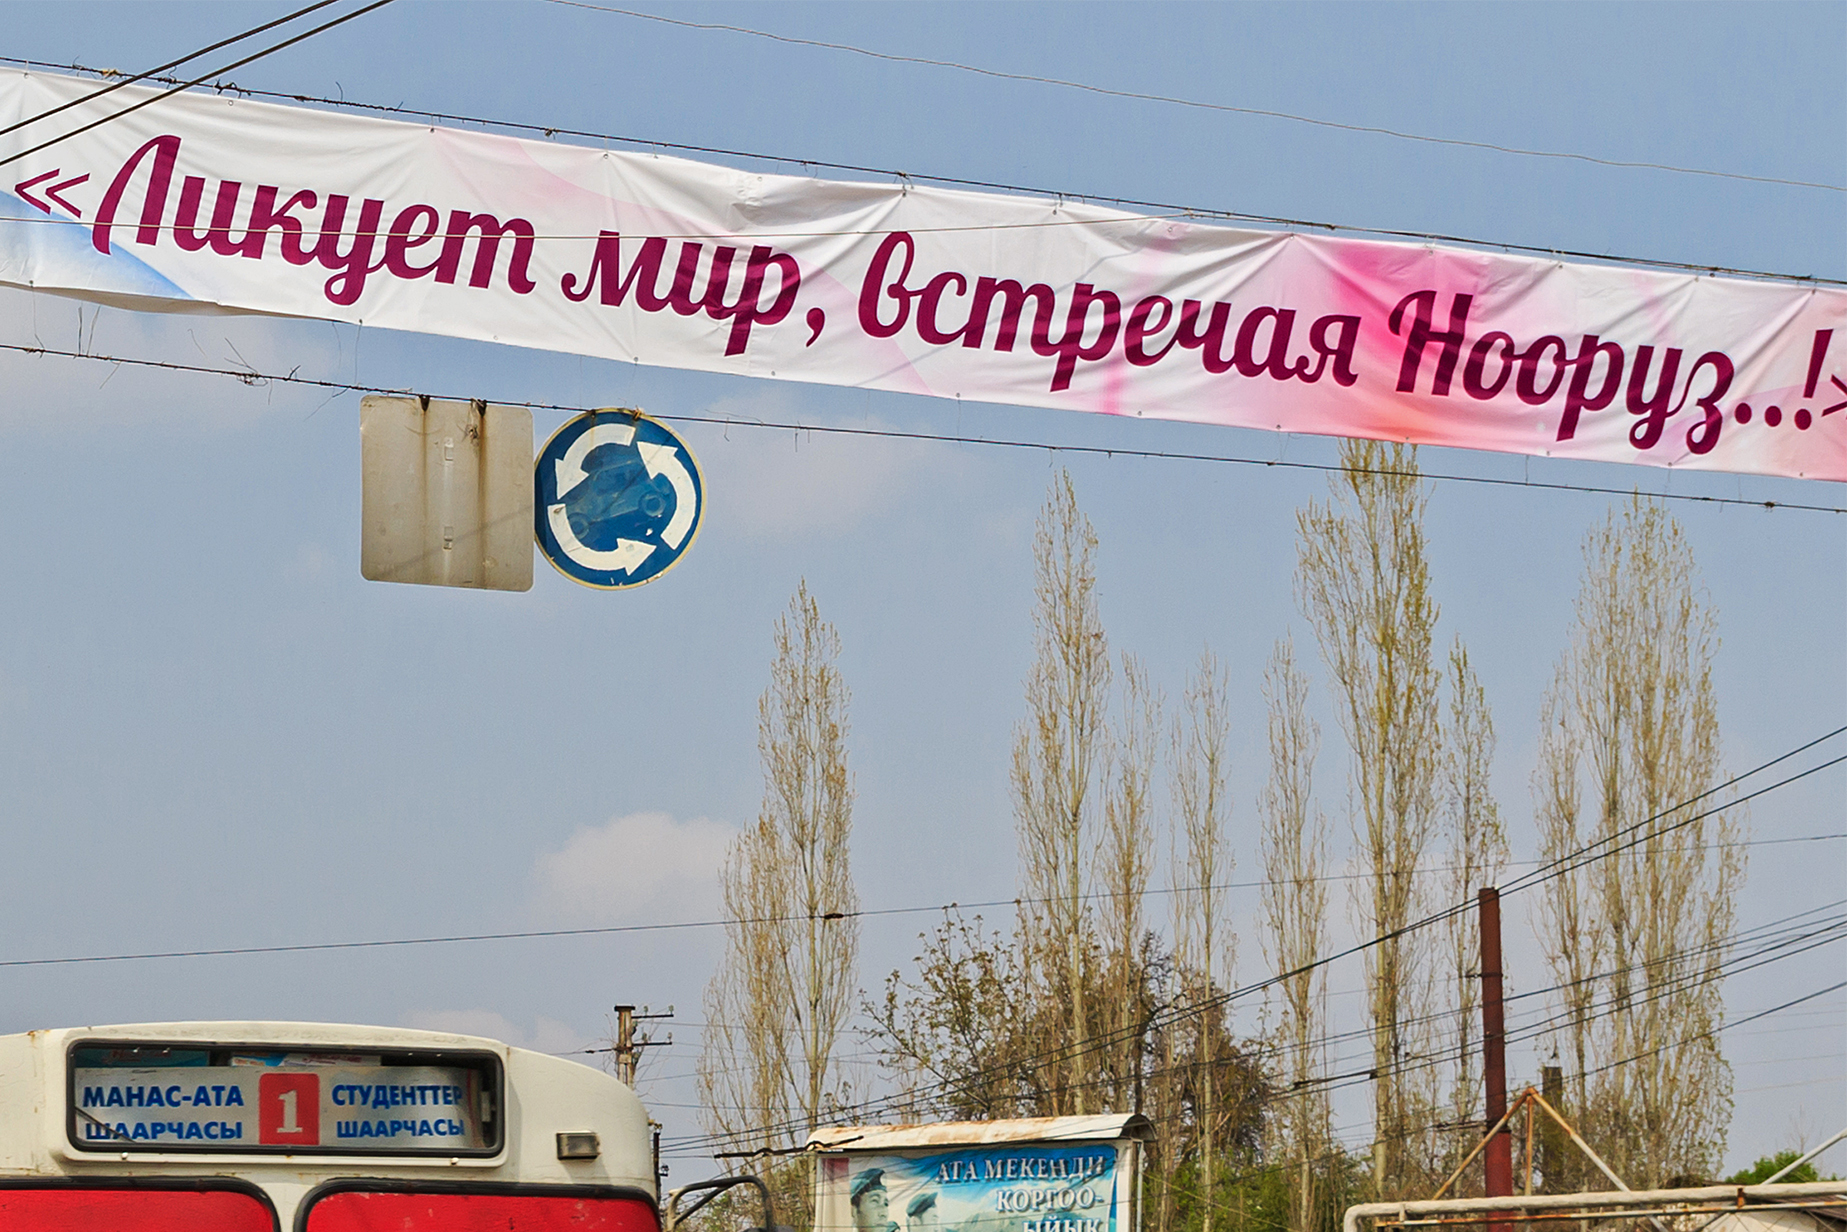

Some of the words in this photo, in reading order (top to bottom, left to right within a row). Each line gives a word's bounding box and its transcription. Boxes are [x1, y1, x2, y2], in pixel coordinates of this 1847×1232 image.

[14, 135, 536, 306] «Ликует
[562, 230, 826, 357] мир,
[859, 231, 1361, 393] встречая
[83, 1084, 244, 1108] МАНАС-АТА
[331, 1084, 463, 1109] СТУДЕНТТЕР
[276, 1089, 302, 1134] 1
[85, 1121, 243, 1141] ШААРЧАСЫ
[336, 1119, 465, 1139] ШААРЧАСЫ
[935, 1161, 978, 1182] АТА
[984, 1156, 1104, 1183] МЕКЕНДИ
[996, 1186, 1104, 1212] КОРГОО-
